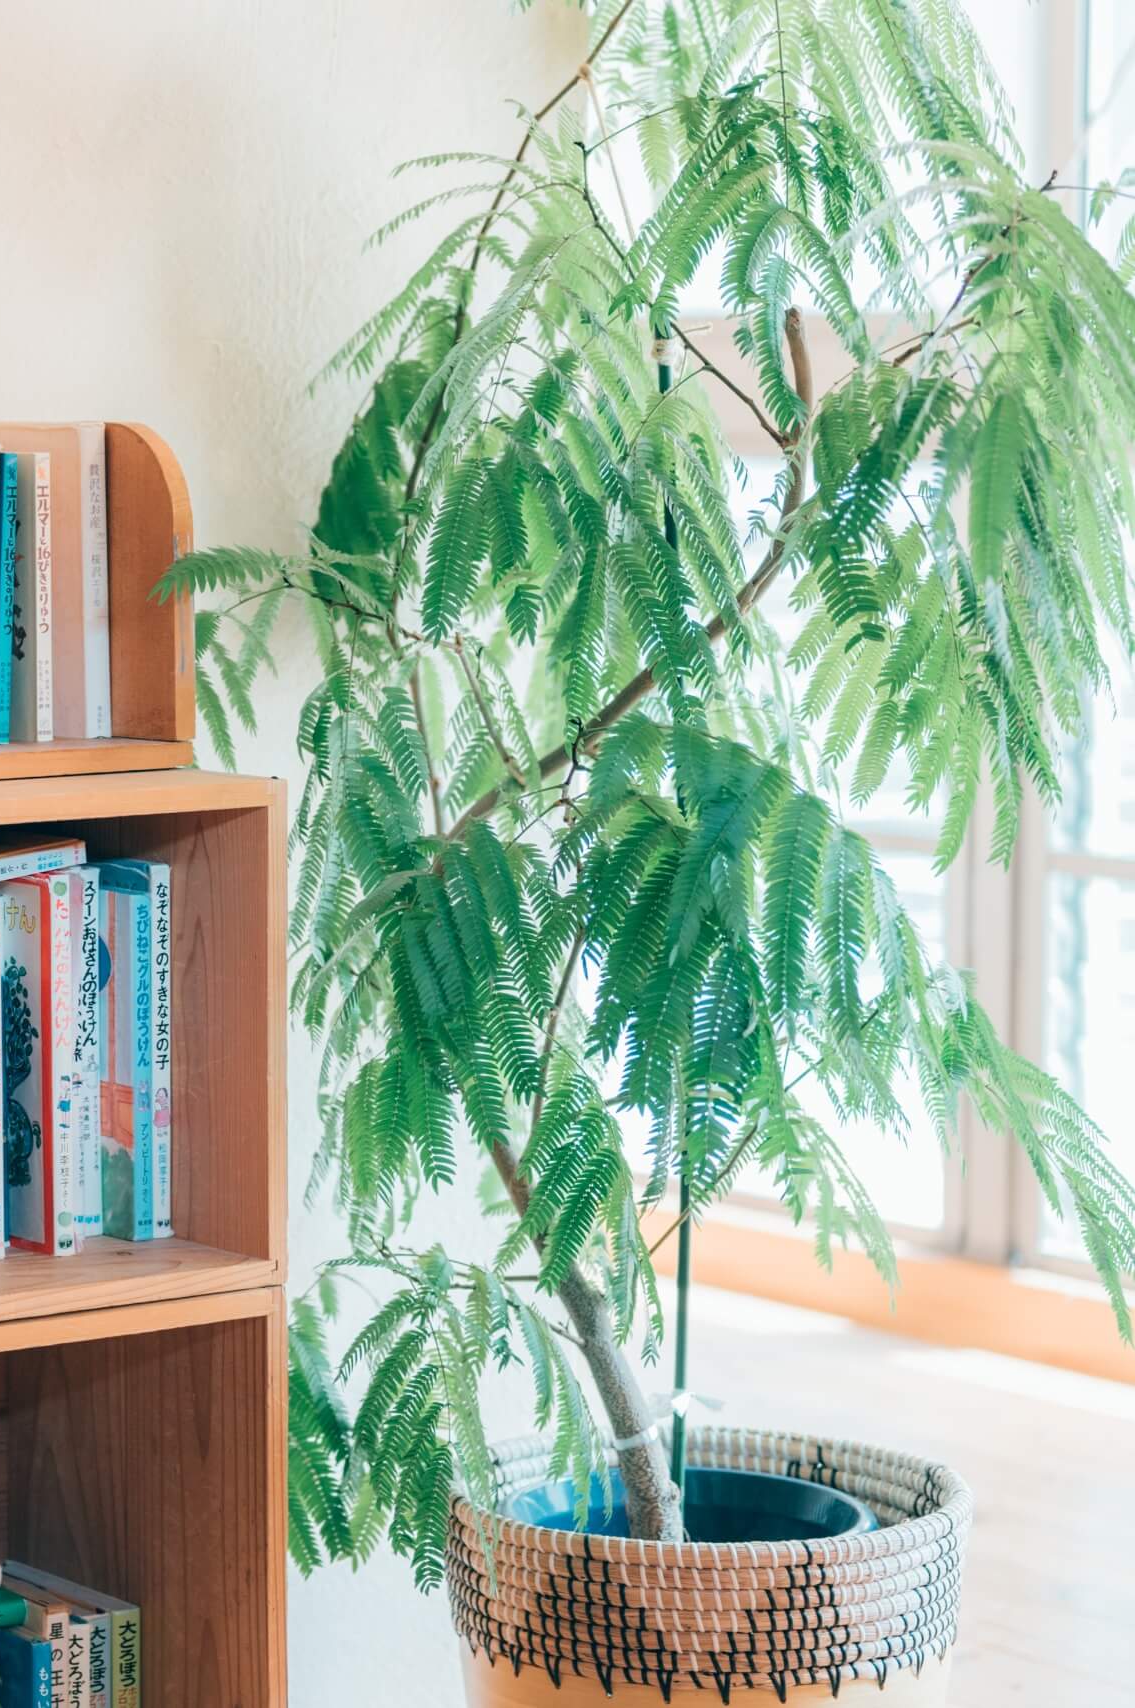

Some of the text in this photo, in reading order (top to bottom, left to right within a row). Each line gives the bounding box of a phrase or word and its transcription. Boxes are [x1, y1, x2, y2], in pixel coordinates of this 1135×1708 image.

[36, 484, 51, 634] エルマーと16ぴきのりゅう
[82, 880, 97, 1048] スプーンおばさんのぼうけん
[155, 881, 170, 1071] なぞなぞのすきな女の子
[89, 1626, 107, 1693] 大どろぼう
[119, 1620, 137, 1687] 大どろぼう
